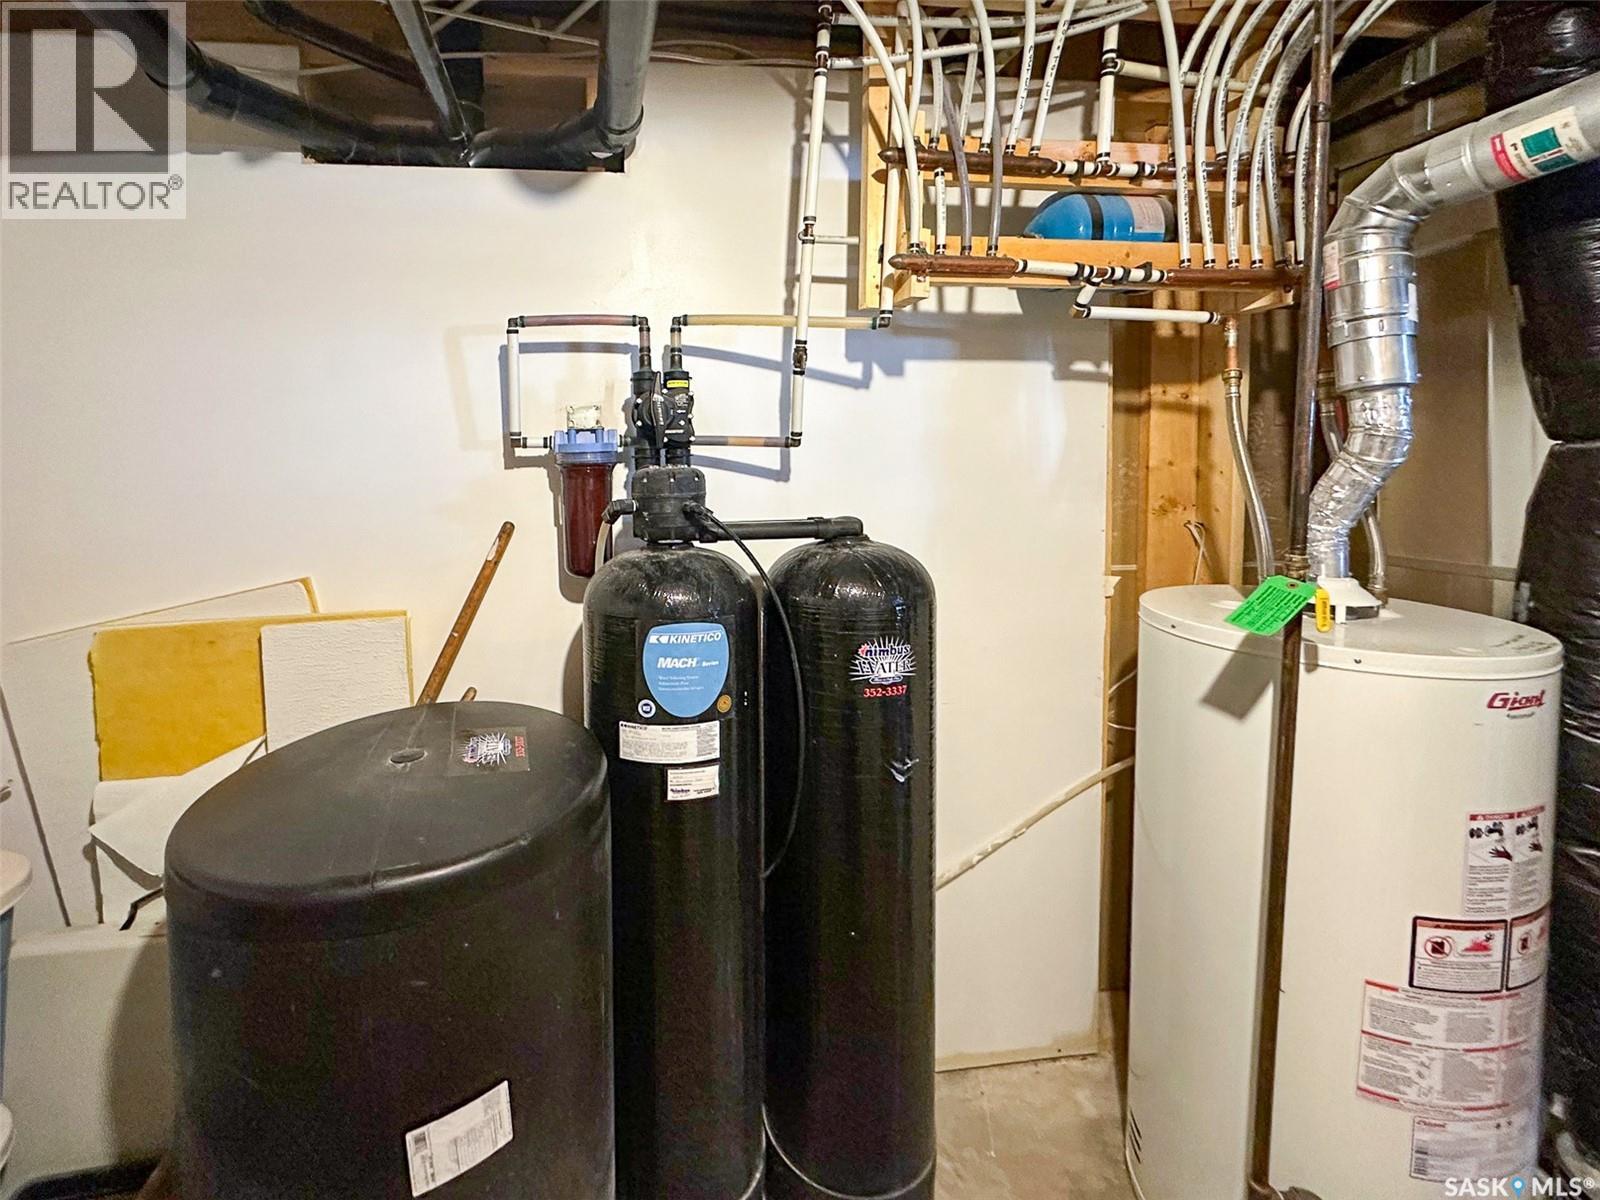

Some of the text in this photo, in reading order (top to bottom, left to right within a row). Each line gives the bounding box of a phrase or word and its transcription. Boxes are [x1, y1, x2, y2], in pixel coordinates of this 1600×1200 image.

[669, 632, 722, 644] KINETICO
[657, 656, 698, 668] MACH
[863, 685, 908, 698] 352-3337
